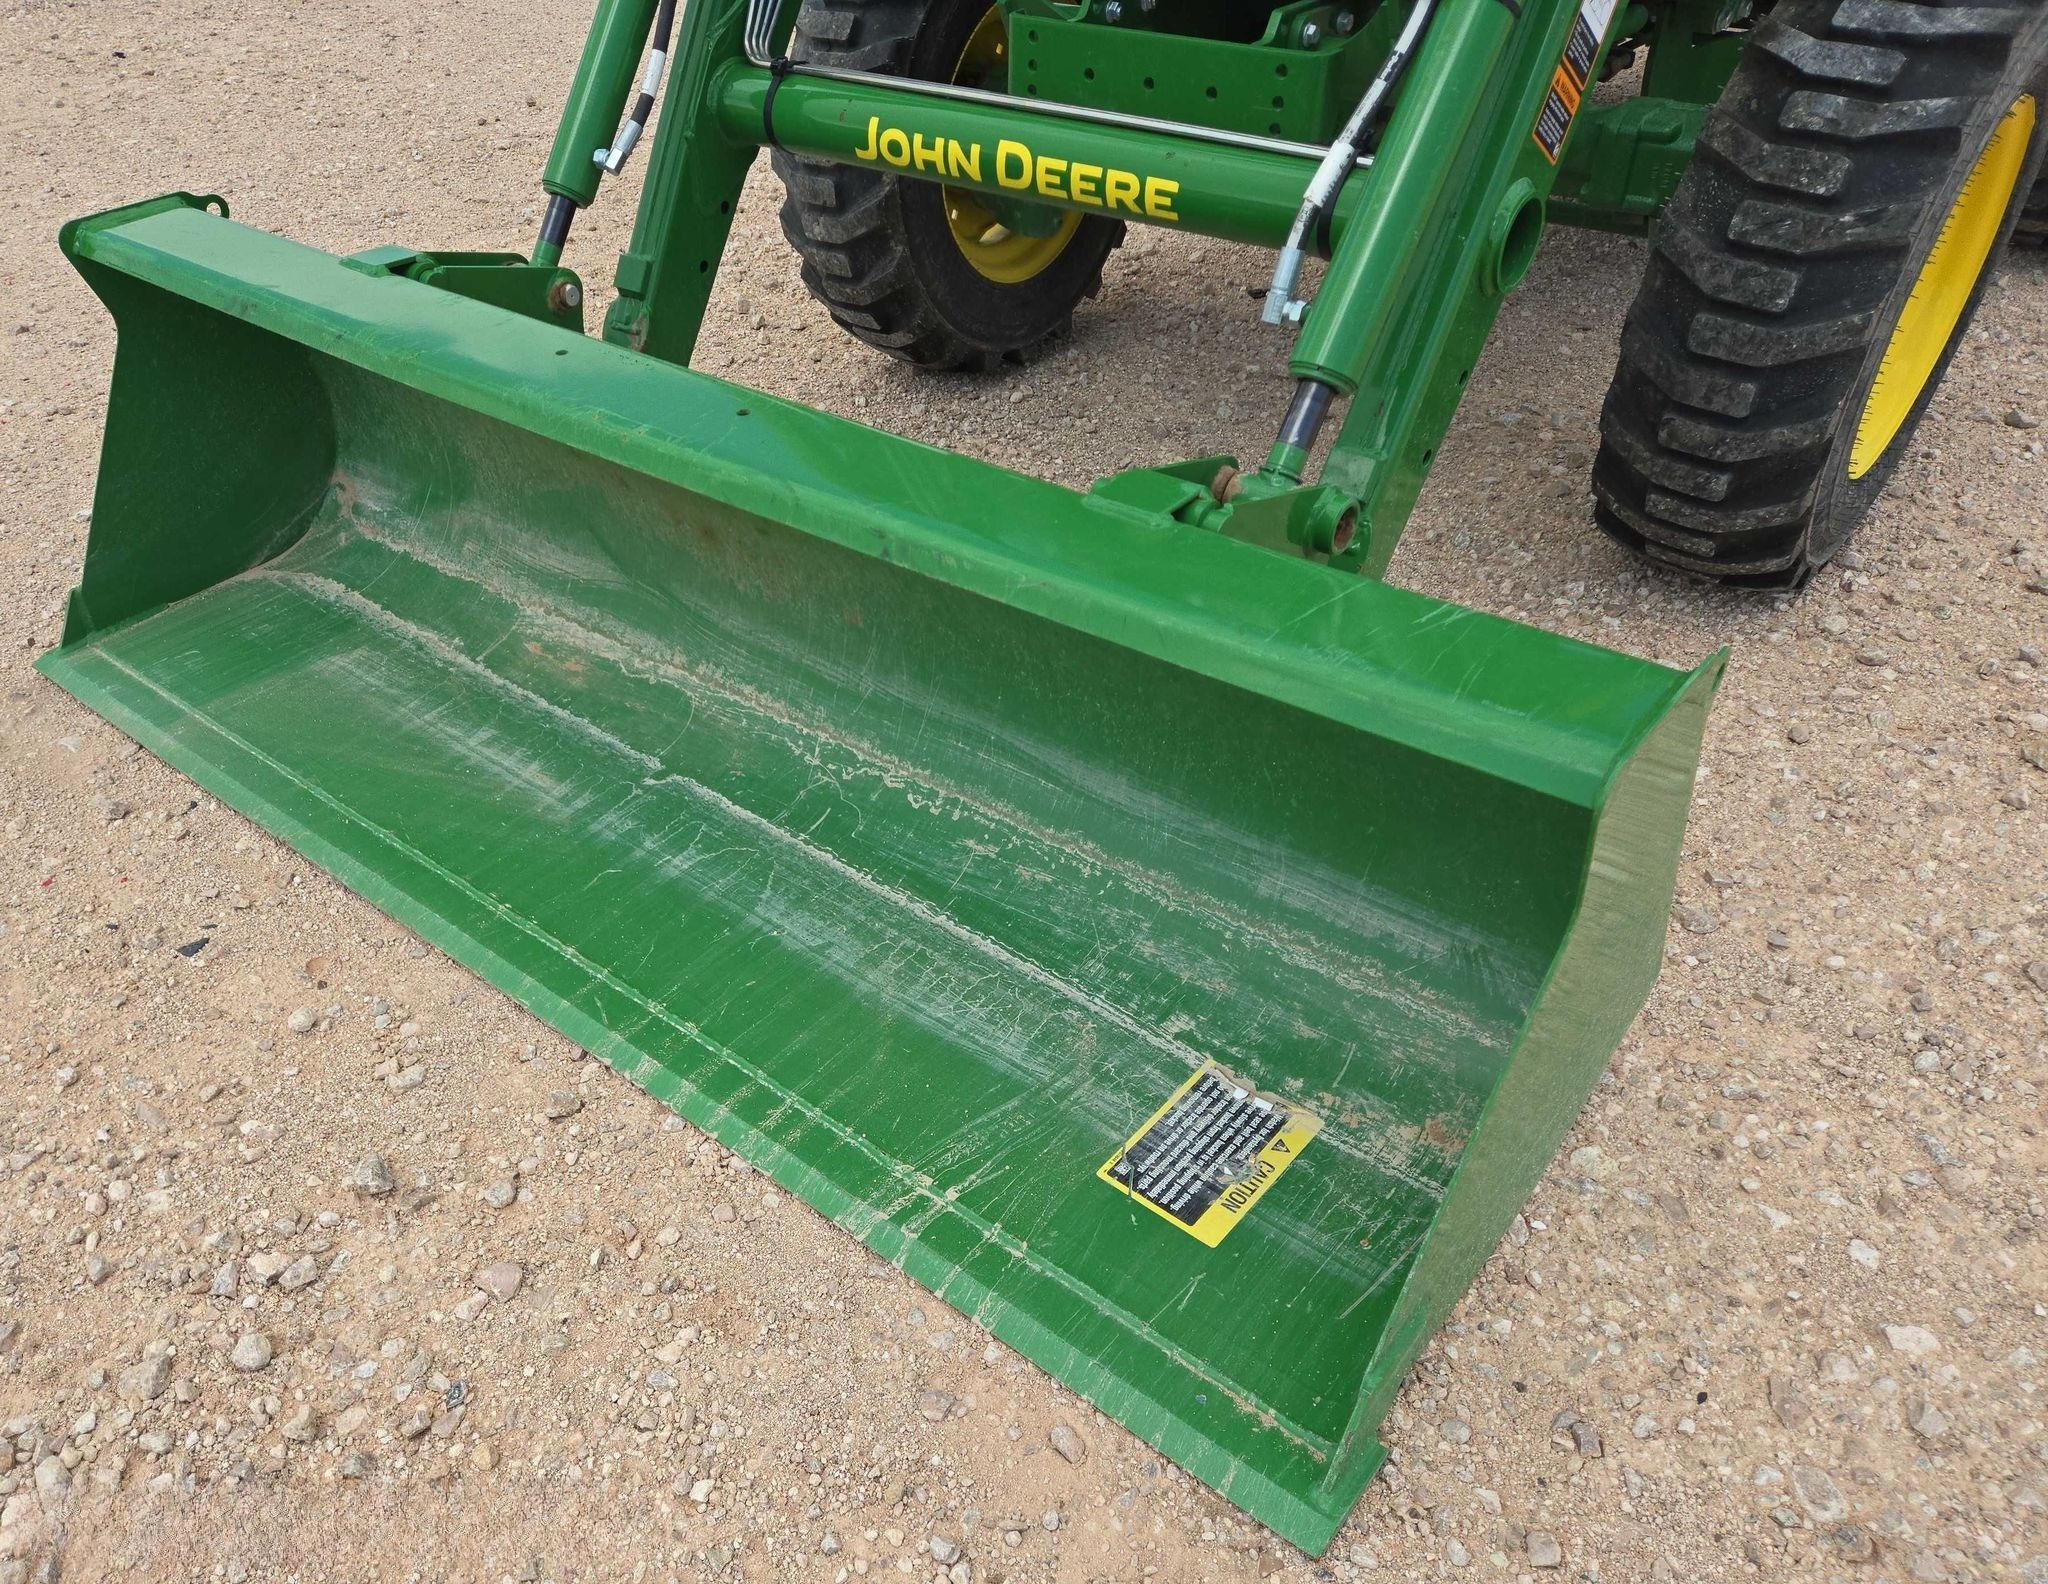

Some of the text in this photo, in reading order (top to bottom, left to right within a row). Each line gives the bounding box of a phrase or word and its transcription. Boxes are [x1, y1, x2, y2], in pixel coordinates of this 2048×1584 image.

[855, 116, 1180, 222] JOHN DEERE
[1198, 1076, 1218, 1093] before
[1209, 1088, 1222, 1099] not
[1191, 1095, 1215, 1115] operate
[1209, 1099, 1228, 1115] tractor
[1163, 1109, 1185, 1128] bucket.
[1179, 1112, 1199, 1129] tractor
[1214, 1111, 1234, 1128] bucket
[1229, 1111, 1250, 1129] slowly
[1248, 1115, 1264, 1128] seat
[1174, 1126, 1184, 1134] or
[1184, 1130, 1199, 1142] and
[1205, 1125, 1221, 1138] from
[1219, 1126, 1237, 1142] when
[1240, 1125, 1255, 1138] belt
[1257, 1127, 1271, 1137] for
[1163, 1132, 1180, 1146] drive
[1186, 1133, 1212, 1156] shipping
[1231, 1134, 1247, 1146] and
[1156, 1143, 1168, 1153] on
[1169, 1138, 1191, 1158] discard
[1205, 1139, 1225, 1157] bucket
[1214, 1143, 1238, 1166] exercise
[1195, 1158, 1207, 1167] in
[1200, 1153, 1211, 1162] is
[1175, 1162, 1202, 1187] shipping
[1198, 1162, 1221, 1183] caution
[1134, 1174, 1155, 1192] parts.
[1145, 1168, 1179, 1200] immediately
[1186, 1179, 1205, 1196] while
[1156, 1182, 1184, 1207] position.
[1167, 1190, 1193, 1214] driving.
